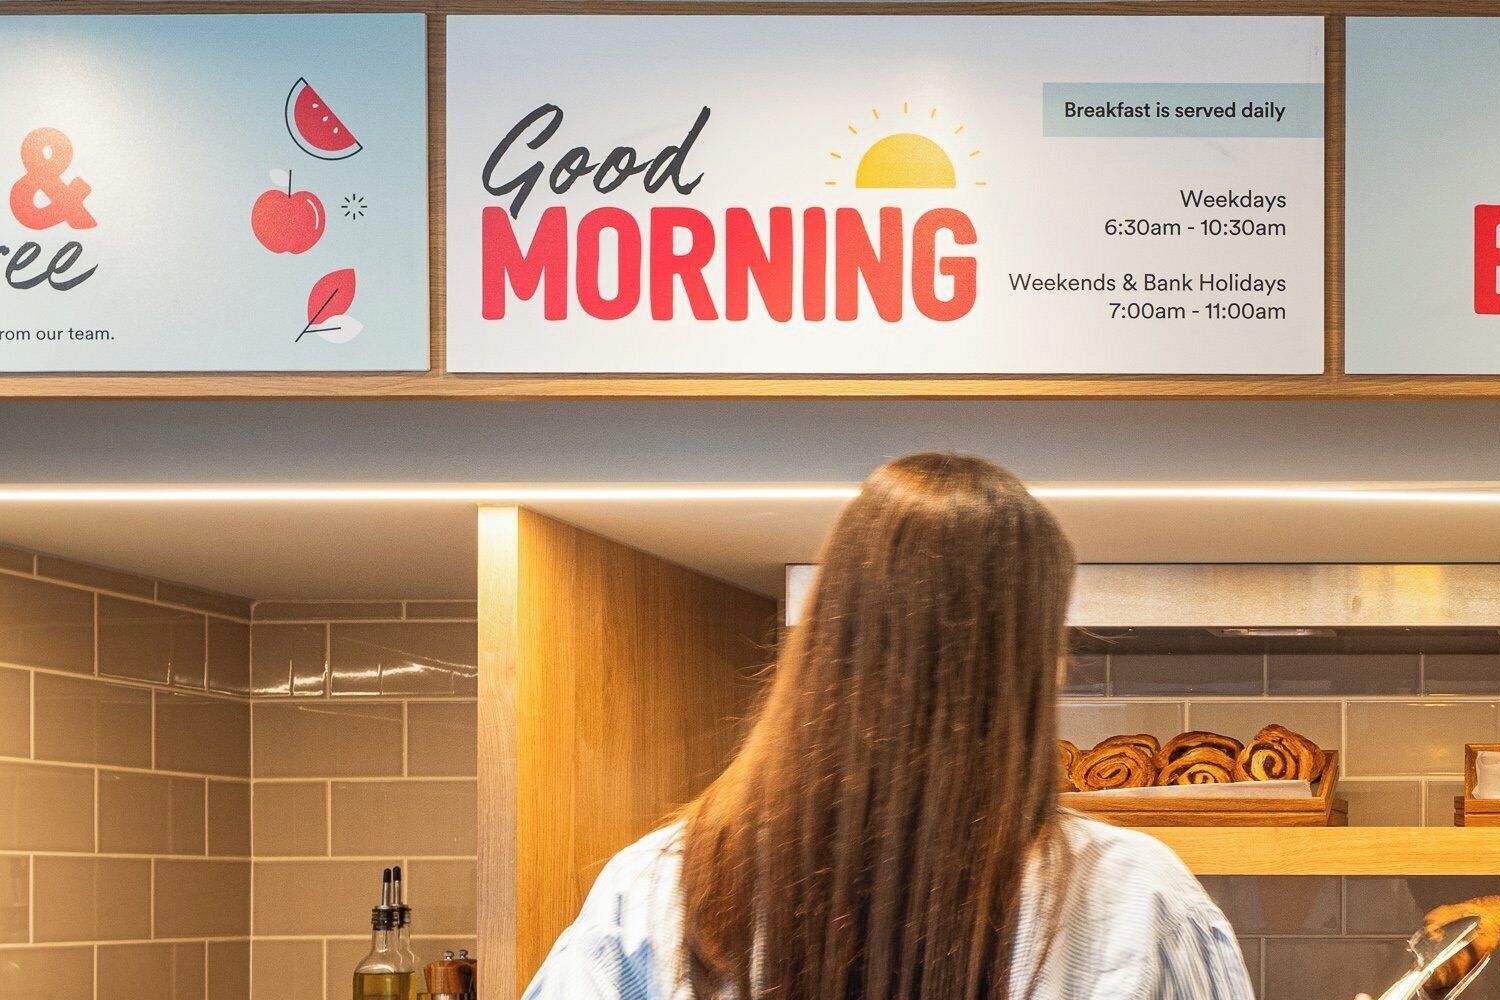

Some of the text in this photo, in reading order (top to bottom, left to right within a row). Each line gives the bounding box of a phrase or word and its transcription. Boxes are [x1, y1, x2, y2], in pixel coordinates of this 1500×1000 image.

[1064, 101, 1286, 122] Breakfast is served daily
[481, 103, 711, 220] Good
[10, 127, 98, 230] &
[1180, 189, 1287, 210] Weekdays
[1104, 218, 1181, 237] 6:30am
[1200, 218, 1287, 237] 10:30am
[0, 241, 99, 292] ee
[481, 205, 979, 323] MORNING
[1008, 273, 1287, 296] Weekends & Bank Holidays
[1109, 302, 1186, 320] 7:00am
[1205, 302, 1287, 320] 11:00am
[36, 330, 63, 341] our
[68, 327, 114, 341] team.
